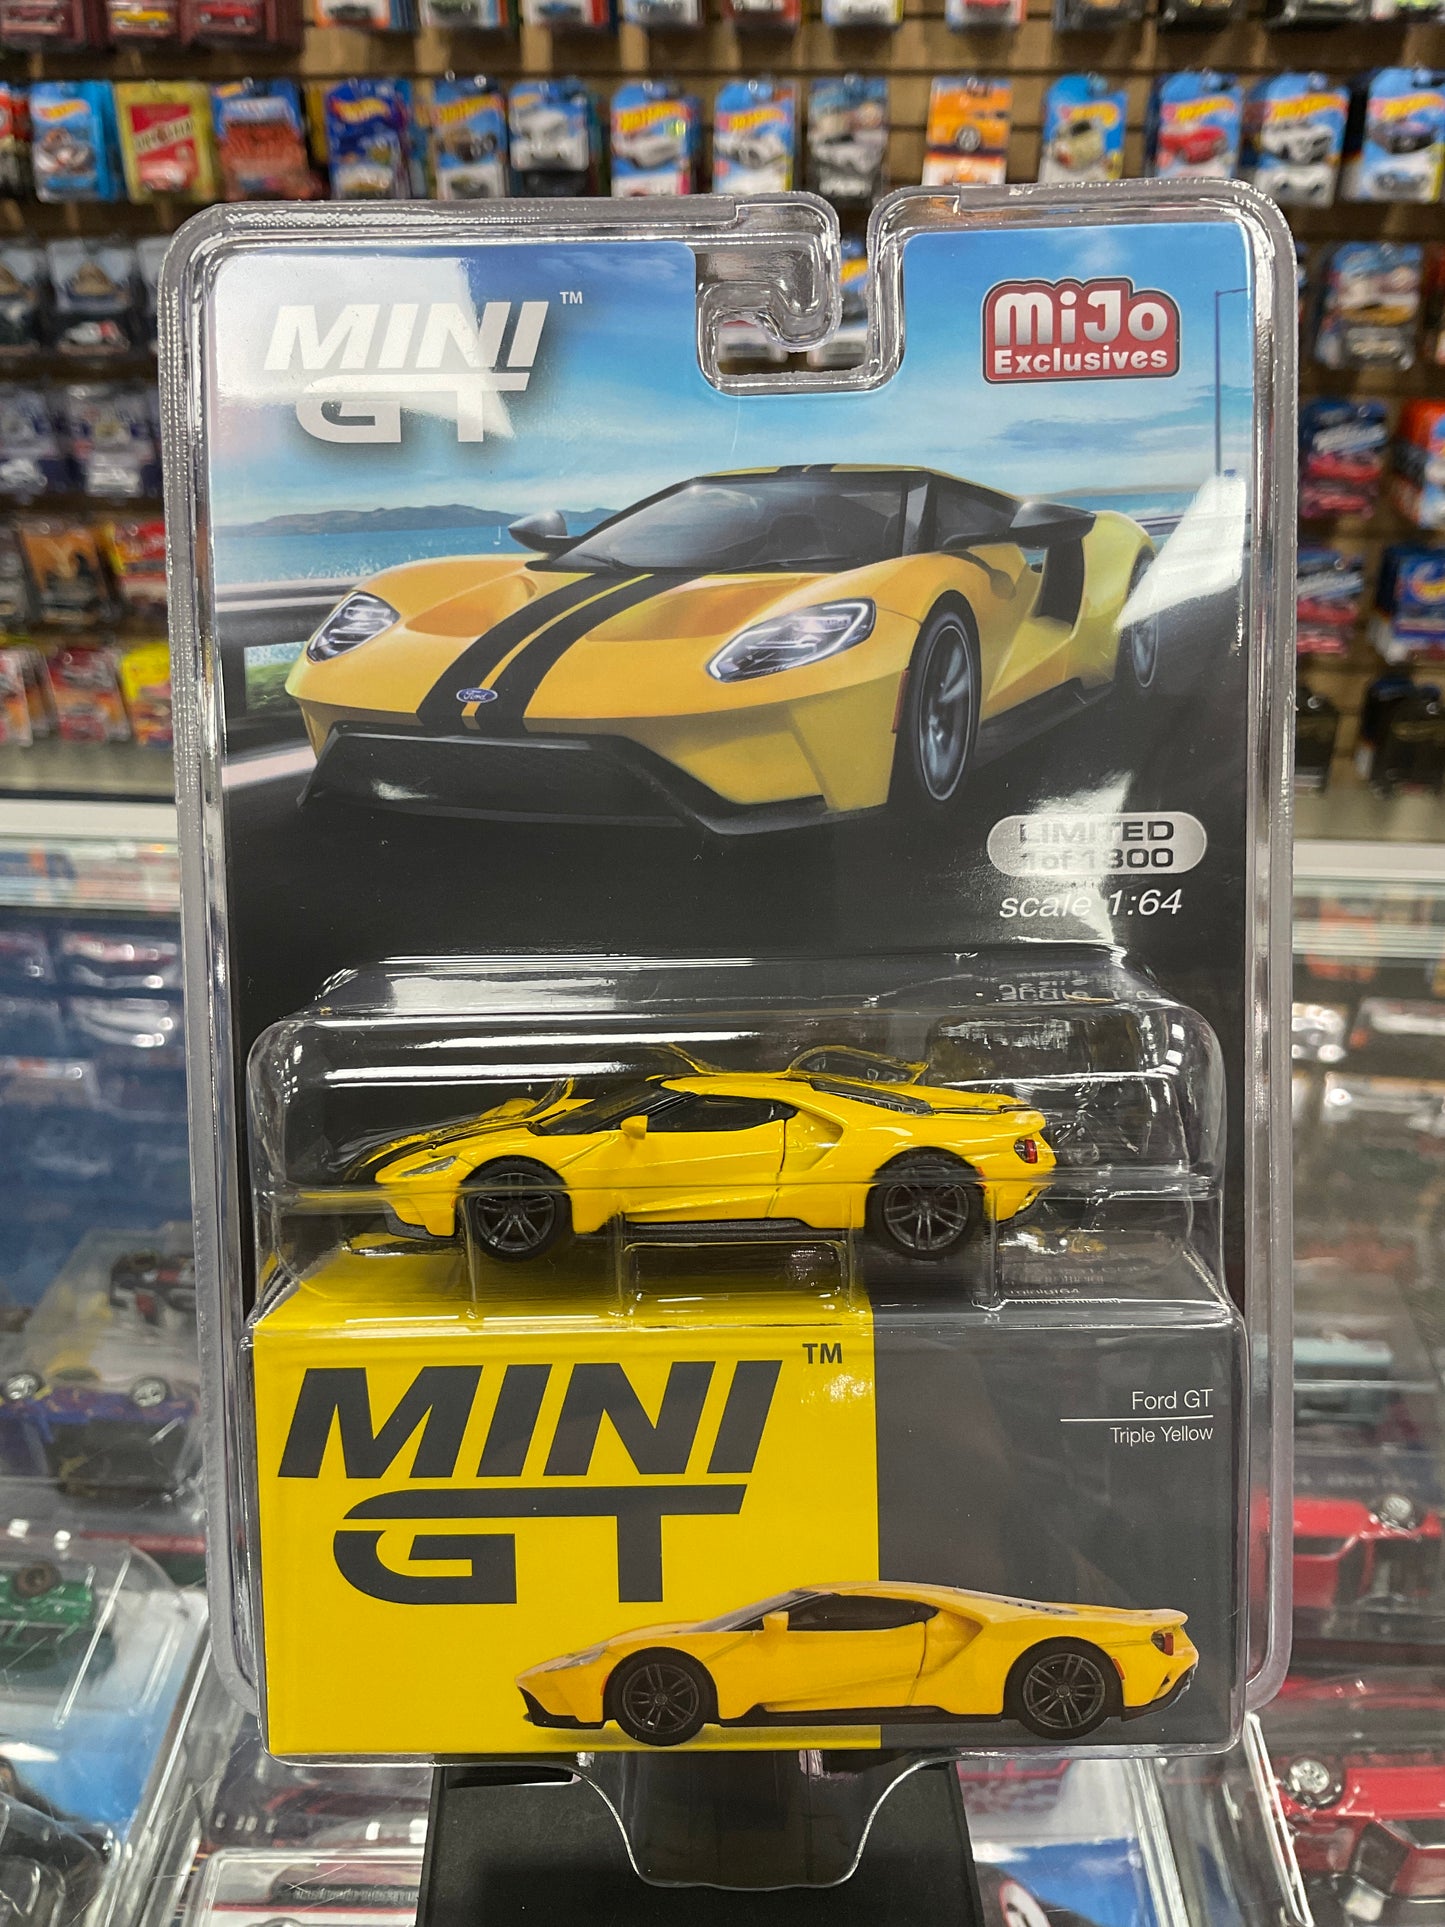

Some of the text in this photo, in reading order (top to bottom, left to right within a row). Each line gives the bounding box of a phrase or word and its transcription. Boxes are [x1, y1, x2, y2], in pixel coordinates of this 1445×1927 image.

[263, 291, 583, 370] MINI TM
[994, 345, 1168, 374] Exclusives
[296, 372, 530, 443] GT
[1019, 820, 1174, 843] LIMITED
[999, 888, 1183, 918] scale 1:64
[277, 1342, 843, 1479] MINI TM
[1132, 1388, 1214, 1410] Ford GT
[1109, 1425, 1214, 1447] Triple Yellow
[333, 1483, 748, 1606] GT
